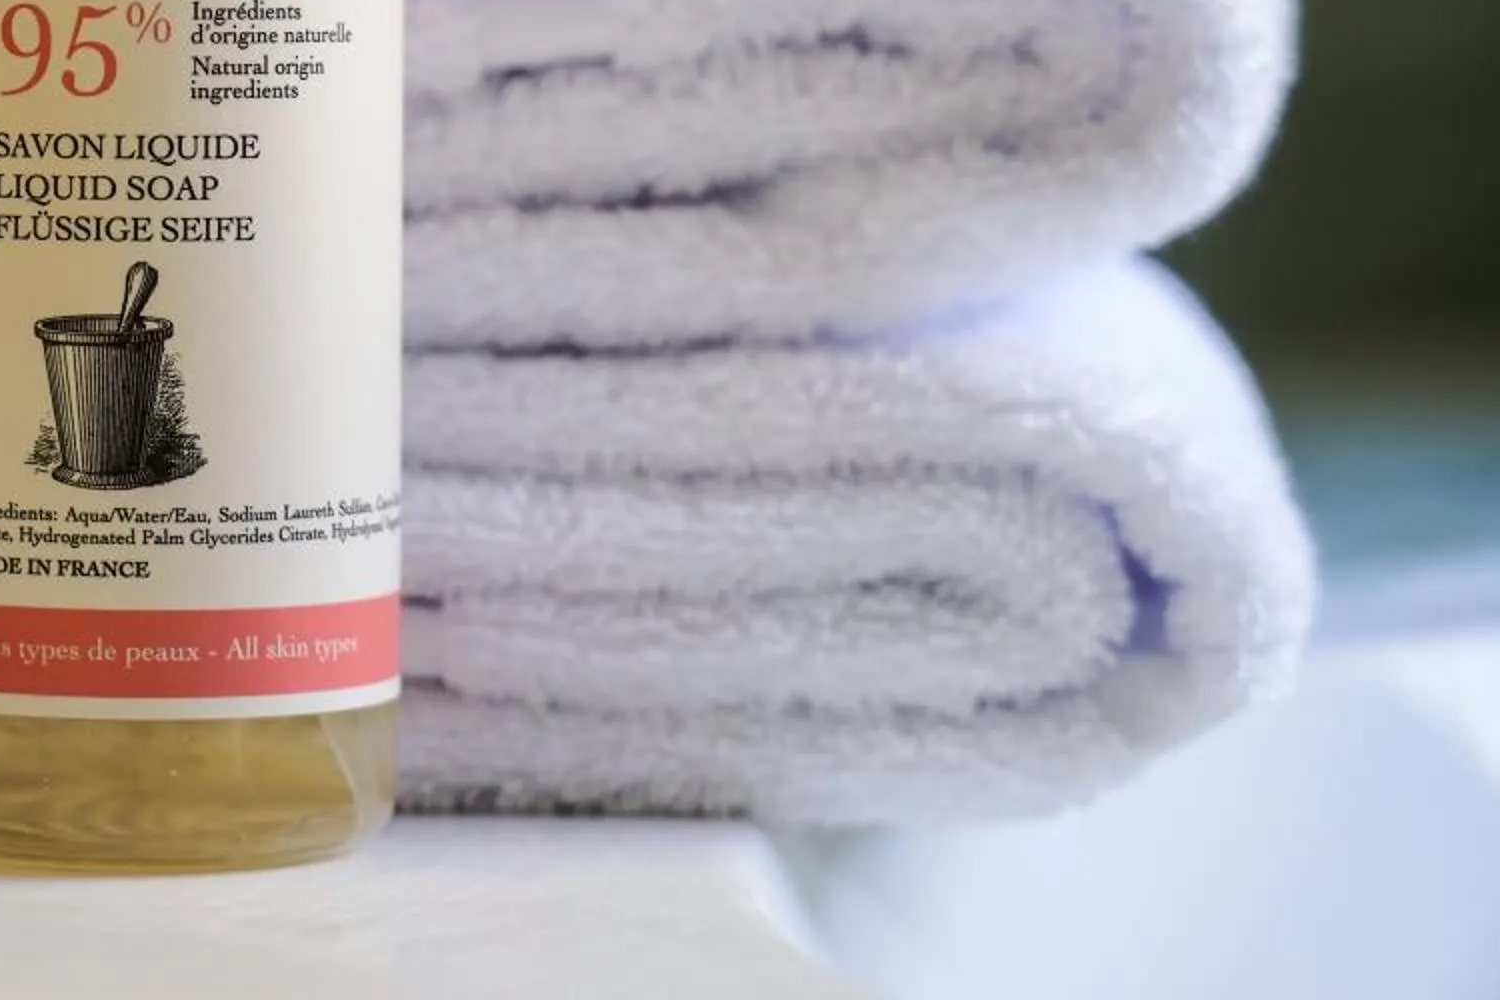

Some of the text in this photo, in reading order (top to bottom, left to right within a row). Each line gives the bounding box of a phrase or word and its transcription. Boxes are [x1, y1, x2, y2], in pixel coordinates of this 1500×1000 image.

[191, 1, 302, 24] Ingrédients
[0, 1, 172, 97] 95%
[191, 23, 353, 50] d'origine naturelle
[192, 55, 325, 80] Natural origin
[190, 80, 299, 104] ingredients
[114, 134, 260, 166] LIQUIDE
[126, 175, 220, 202] SOAP
[160, 215, 256, 243] SEIFE
[64, 506, 212, 528] Aqua/Water/Eau,
[219, 506, 277, 523] Sodium
[283, 501, 334, 521] Laureth
[19, 527, 136, 549] Hydrogenated
[142, 528, 184, 545] Palm
[190, 526, 274, 549] Glycerides
[28, 557, 51, 576] IN
[57, 559, 151, 579] FRANCE
[19, 639, 80, 665] types
[88, 637, 117, 662] de
[126, 645, 200, 669] peaux
[226, 635, 259, 660] All
[266, 633, 308, 659] skin
[314, 635, 358, 664] types
